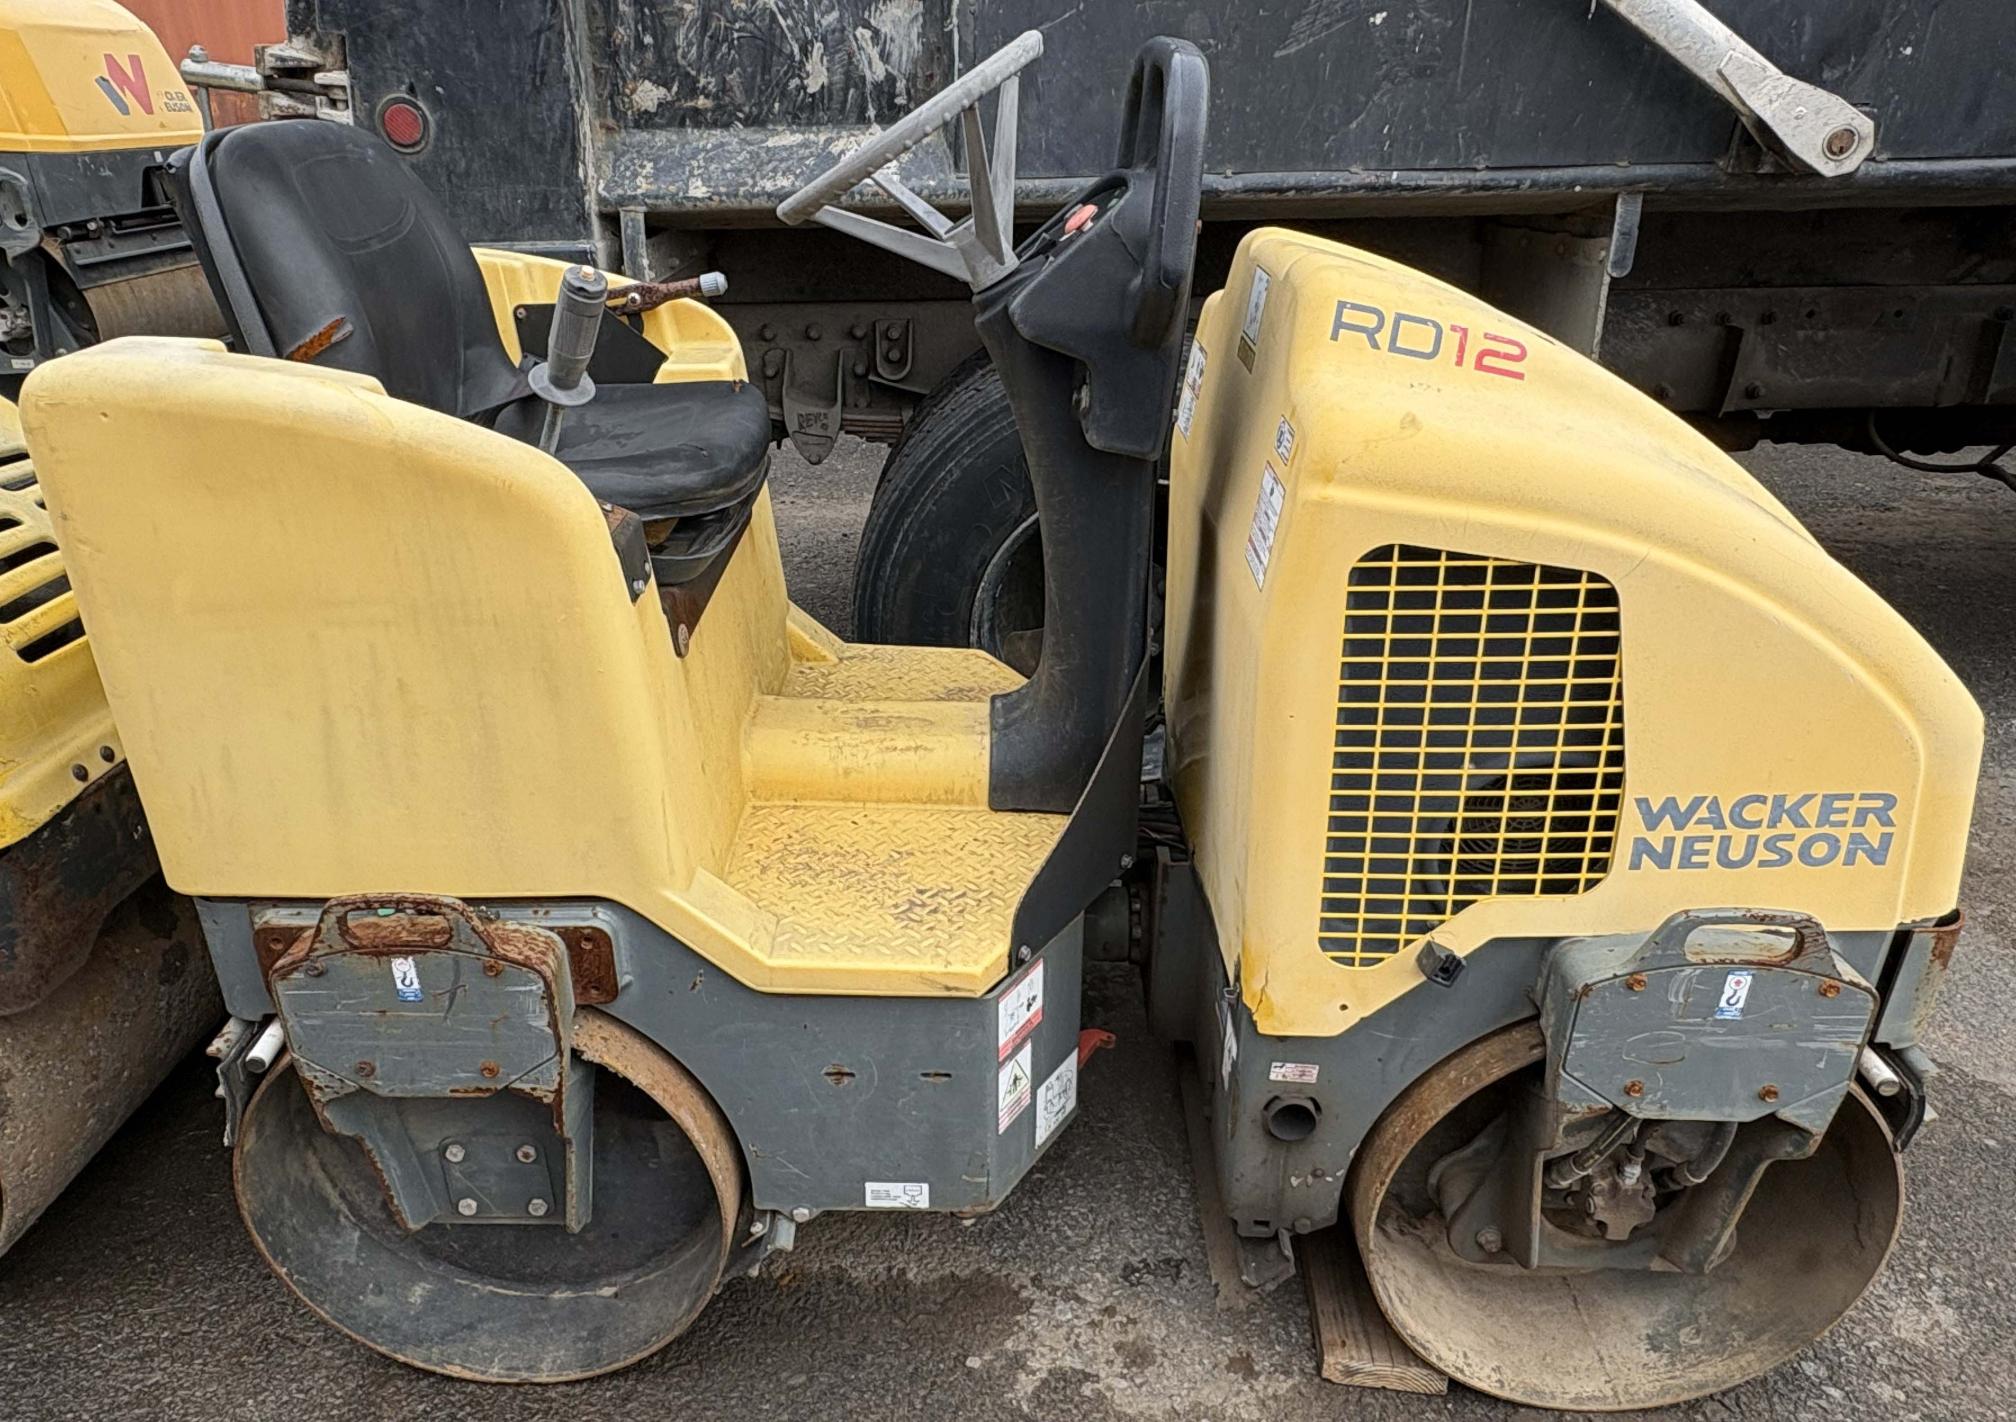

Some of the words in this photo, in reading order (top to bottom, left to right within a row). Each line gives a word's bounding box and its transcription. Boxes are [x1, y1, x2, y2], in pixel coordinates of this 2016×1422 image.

[1330, 299, 1528, 381] RD12
[1634, 792, 1898, 832] WACKER
[1628, 832, 1895, 870] NEUSON
